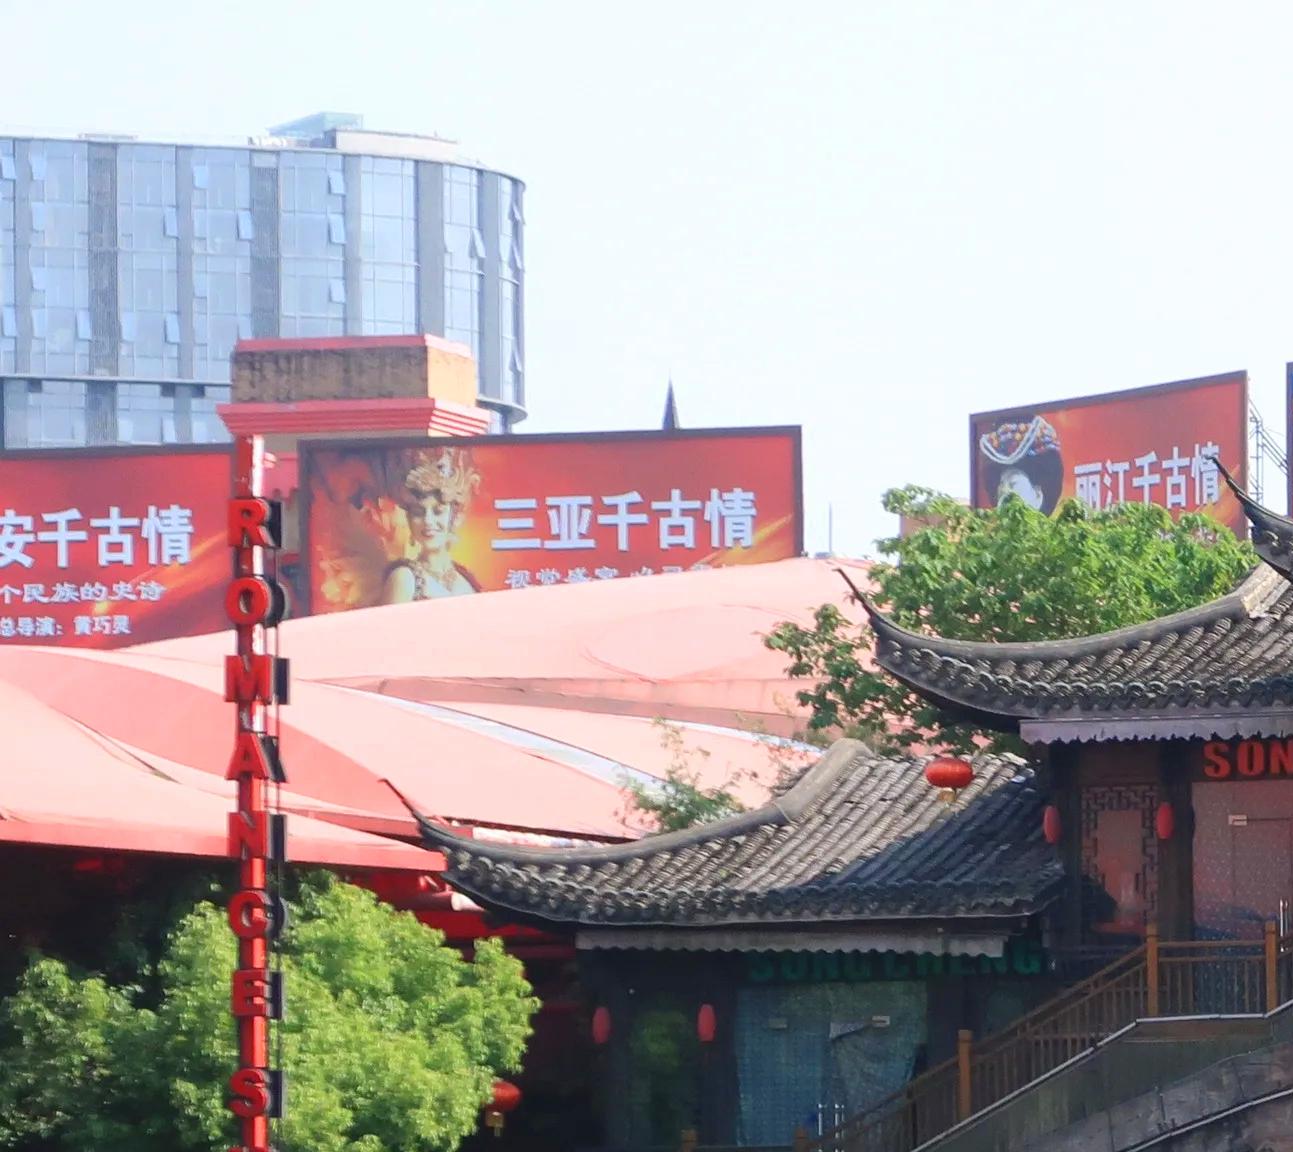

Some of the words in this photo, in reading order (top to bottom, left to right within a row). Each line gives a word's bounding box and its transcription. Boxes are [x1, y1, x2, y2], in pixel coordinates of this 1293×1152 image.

[1073, 441, 1220, 520] 丽江千古情
[0, 504, 194, 569] 安千古情
[491, 487, 757, 551] 三亚千古情
[224, 498, 274, 1018] ROMANCE
